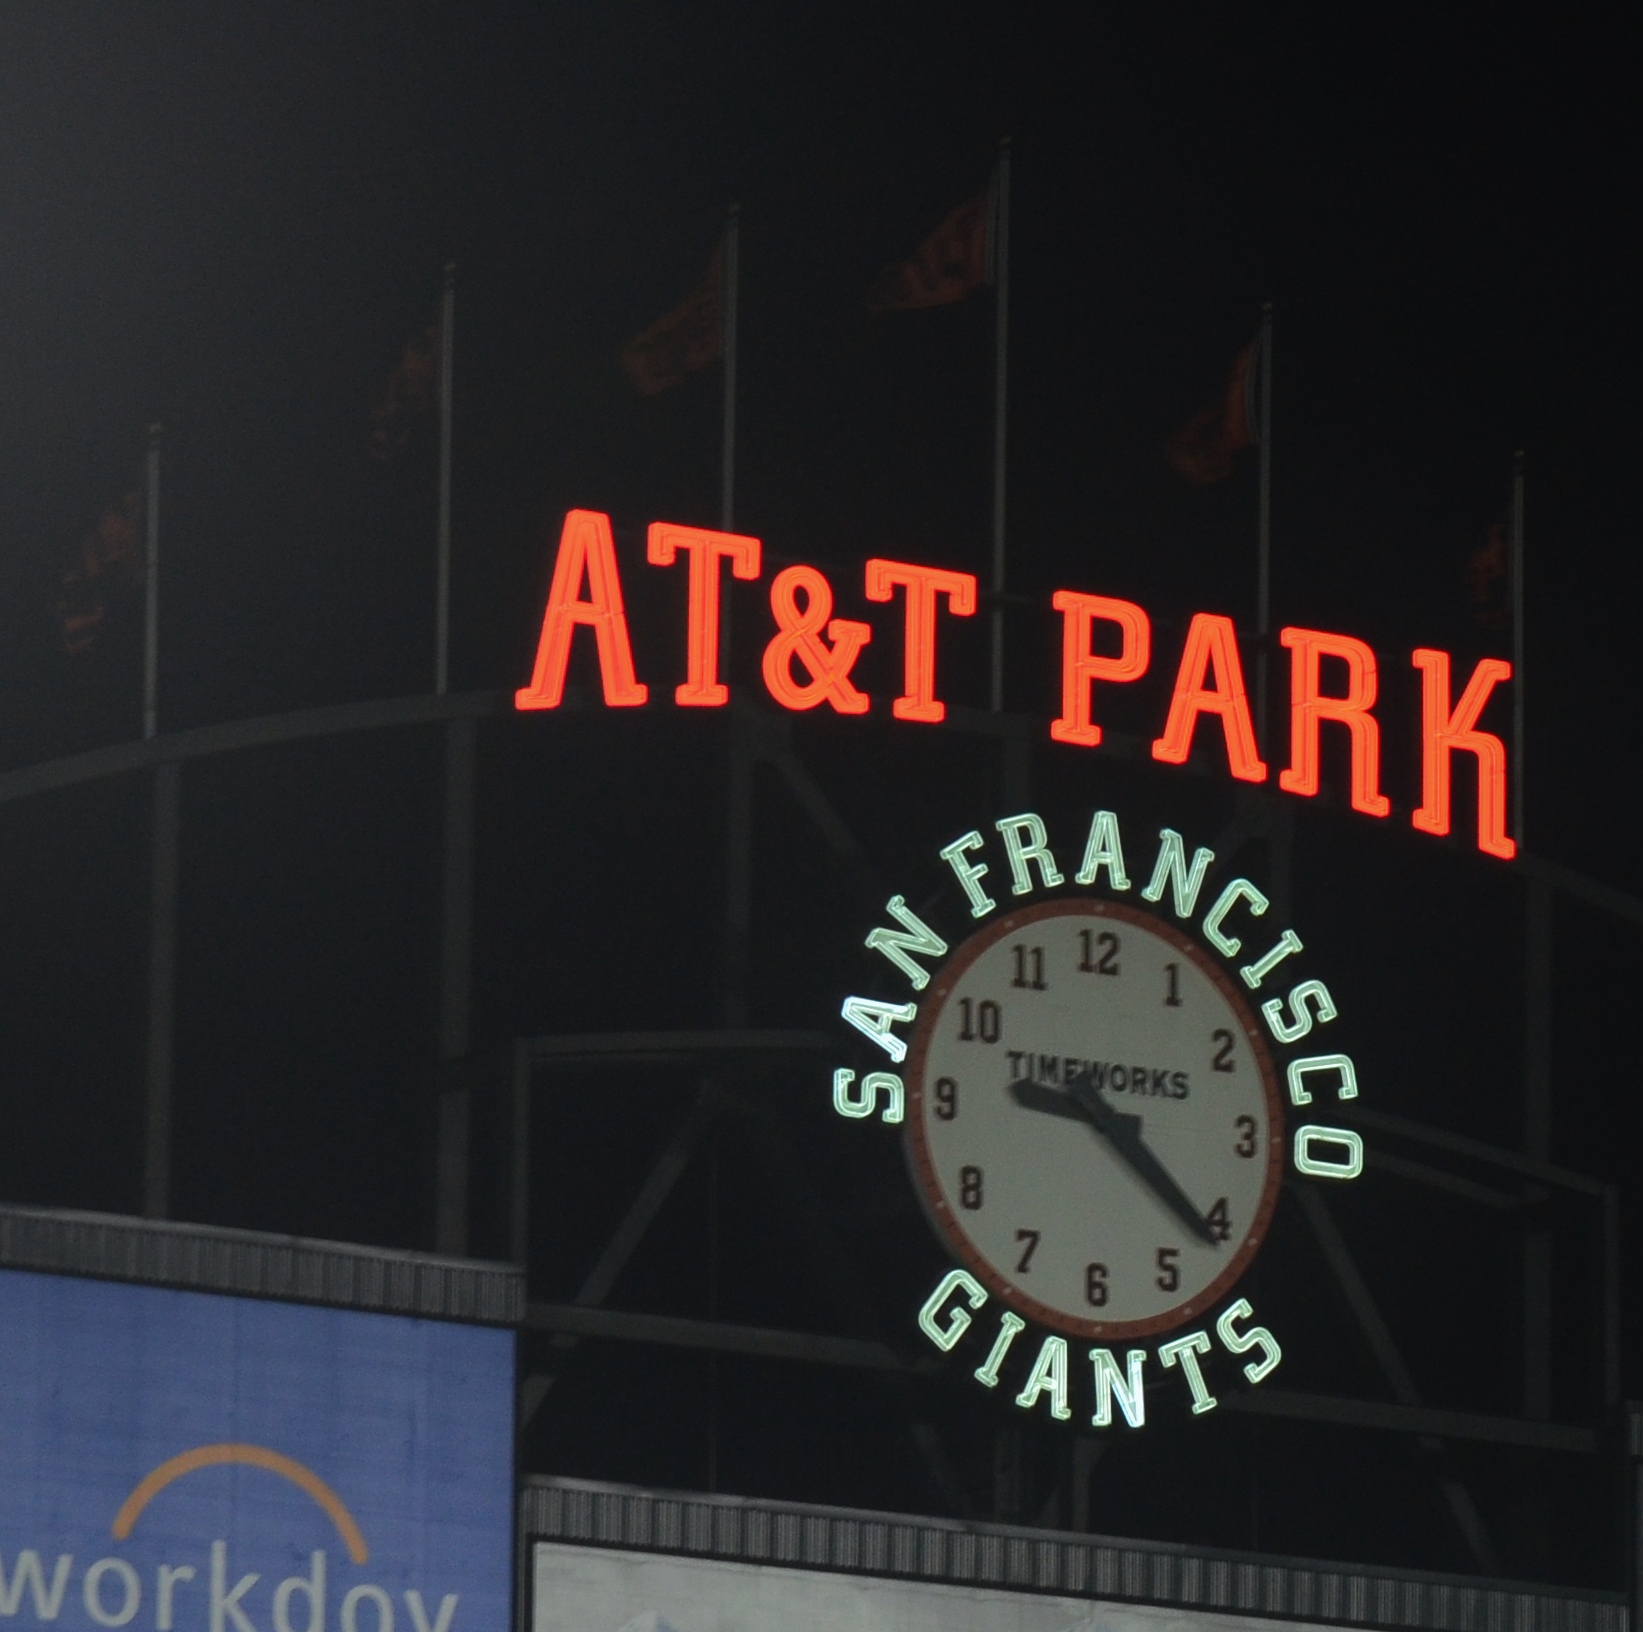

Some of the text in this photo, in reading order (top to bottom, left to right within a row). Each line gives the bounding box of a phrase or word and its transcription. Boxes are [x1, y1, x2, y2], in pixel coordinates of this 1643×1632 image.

[516, 509, 1516, 860] AT&T PARK
[1011, 944, 1048, 992] 11
[1076, 927, 1121, 978] 12
[833, 811, 1363, 1179] SAN FRANCISCO
[1163, 963, 1184, 1009] 1
[957, 999, 1000, 1046] 10
[1210, 1028, 1237, 1074] 2
[934, 1077, 959, 1121] 9
[1005, 1050, 1191, 1102] TIMEWORKS
[1234, 1115, 1258, 1161] 3
[959, 1166, 984, 1211] 8
[1014, 1230, 1042, 1275] 7
[1155, 1247, 1181, 1293] 5
[1085, 1262, 1109, 1308] 6
[918, 1269, 1282, 1428] GIANTS
